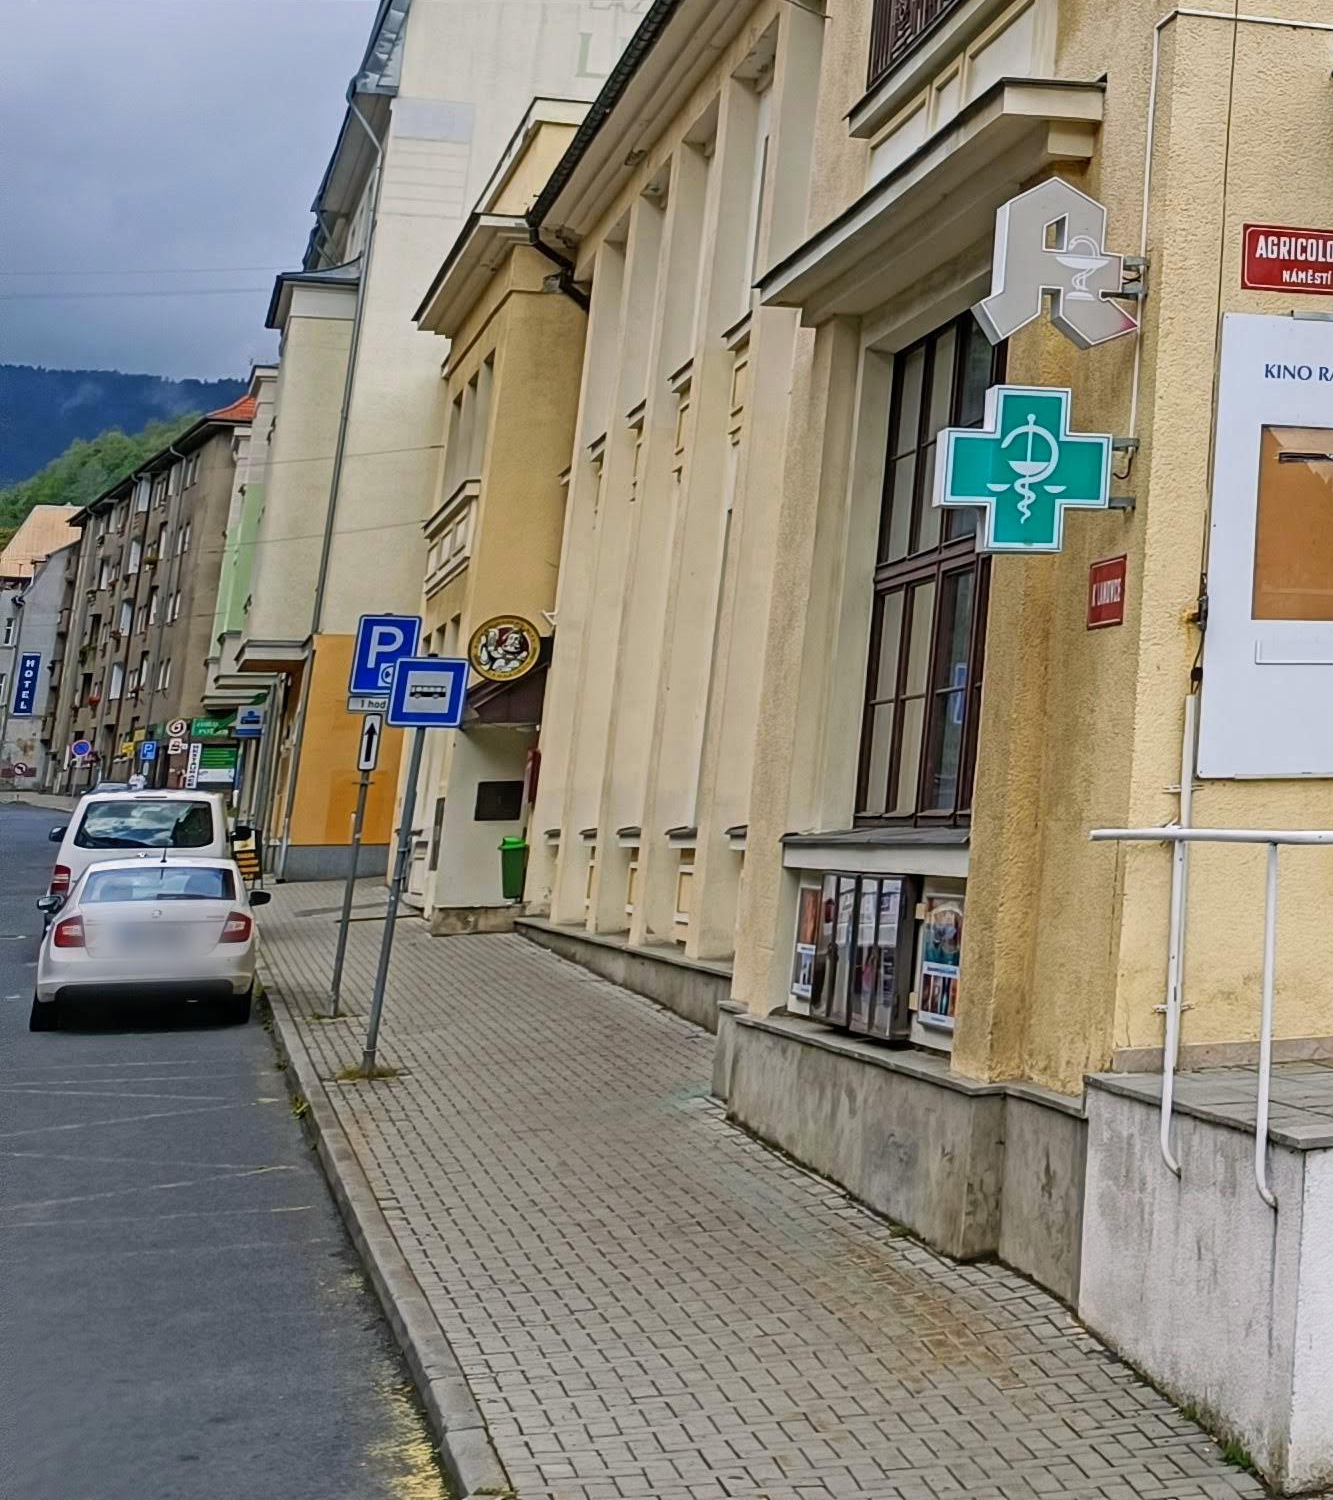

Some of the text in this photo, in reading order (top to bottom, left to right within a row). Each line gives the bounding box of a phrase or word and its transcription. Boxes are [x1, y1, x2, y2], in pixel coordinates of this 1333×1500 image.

[1282, 268, 1332, 285] NÁMĚSTÍ
[1264, 363, 1312, 381] KINO
[367, 625, 405, 669] P
[20, 659, 36, 710] HOTEL
